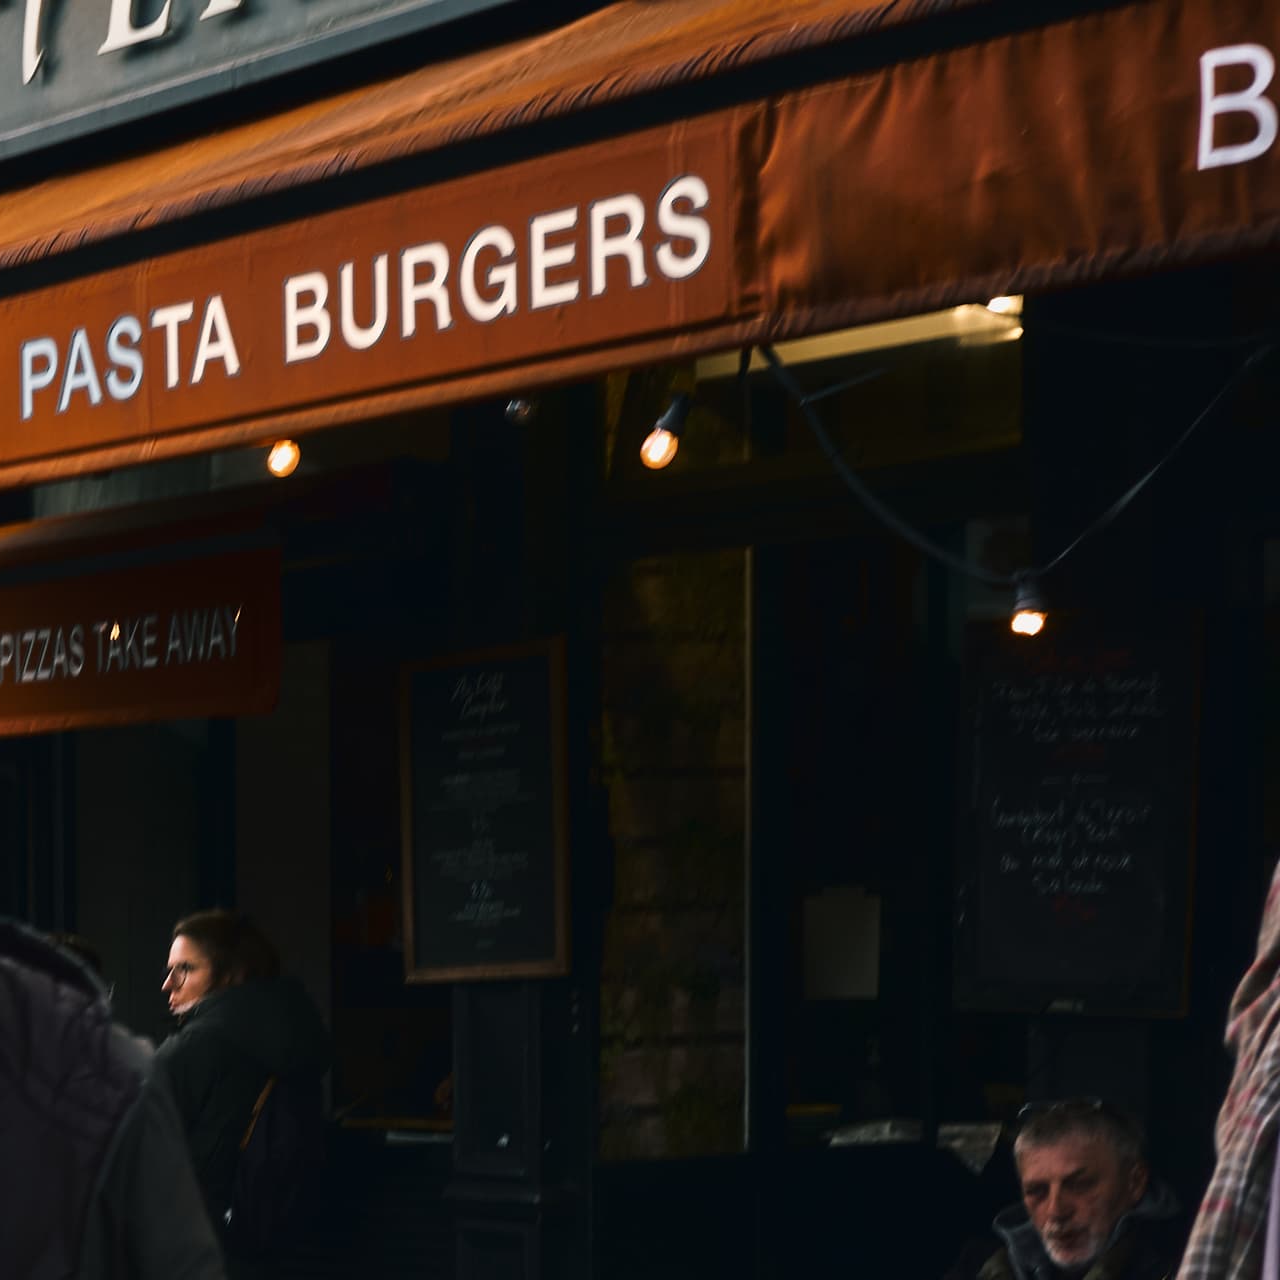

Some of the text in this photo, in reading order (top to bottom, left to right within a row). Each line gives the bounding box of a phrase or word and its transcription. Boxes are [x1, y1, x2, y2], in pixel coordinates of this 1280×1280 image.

[20, 294, 241, 421] PASTA
[282, 173, 711, 366] BURGERS
[92, 613, 159, 674] TAKE
[165, 605, 243, 665] AWAY
